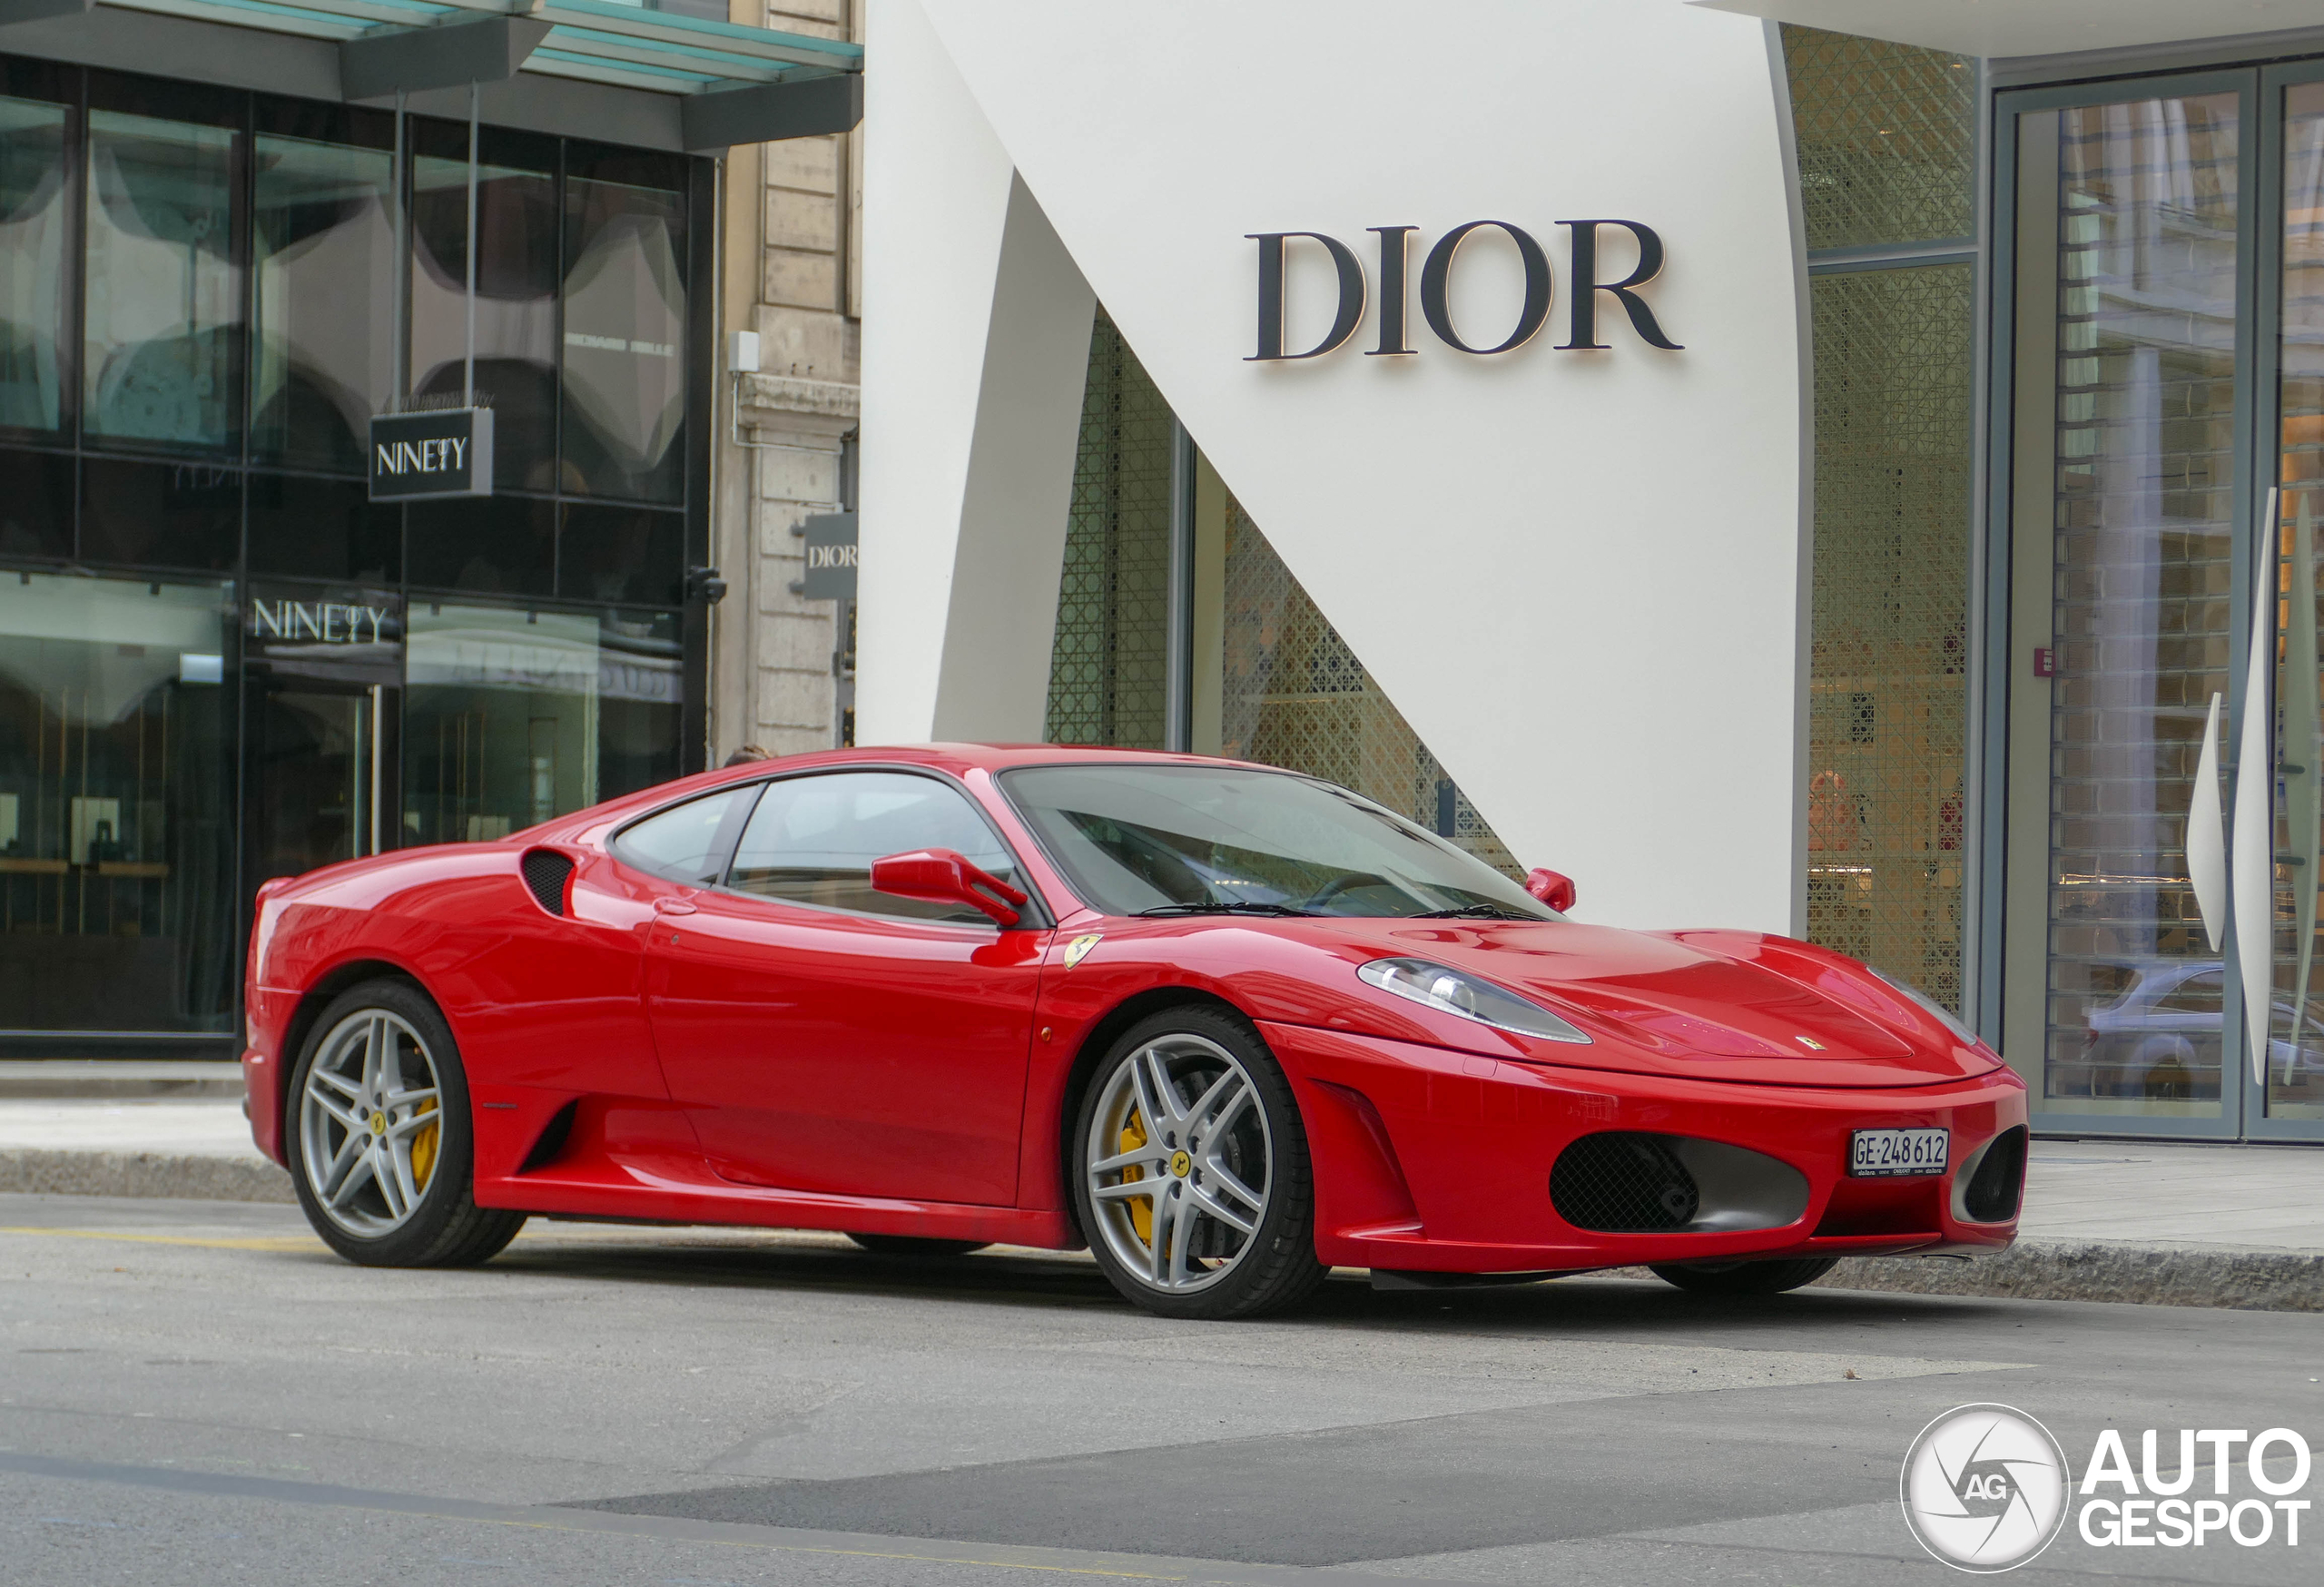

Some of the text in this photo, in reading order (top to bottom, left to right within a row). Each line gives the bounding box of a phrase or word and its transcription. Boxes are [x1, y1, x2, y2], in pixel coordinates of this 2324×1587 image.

[1242, 219, 1687, 362] DIOR
[378, 437, 468, 476] NINETY
[809, 545, 858, 568] DIOR
[254, 598, 387, 645] NINETY
